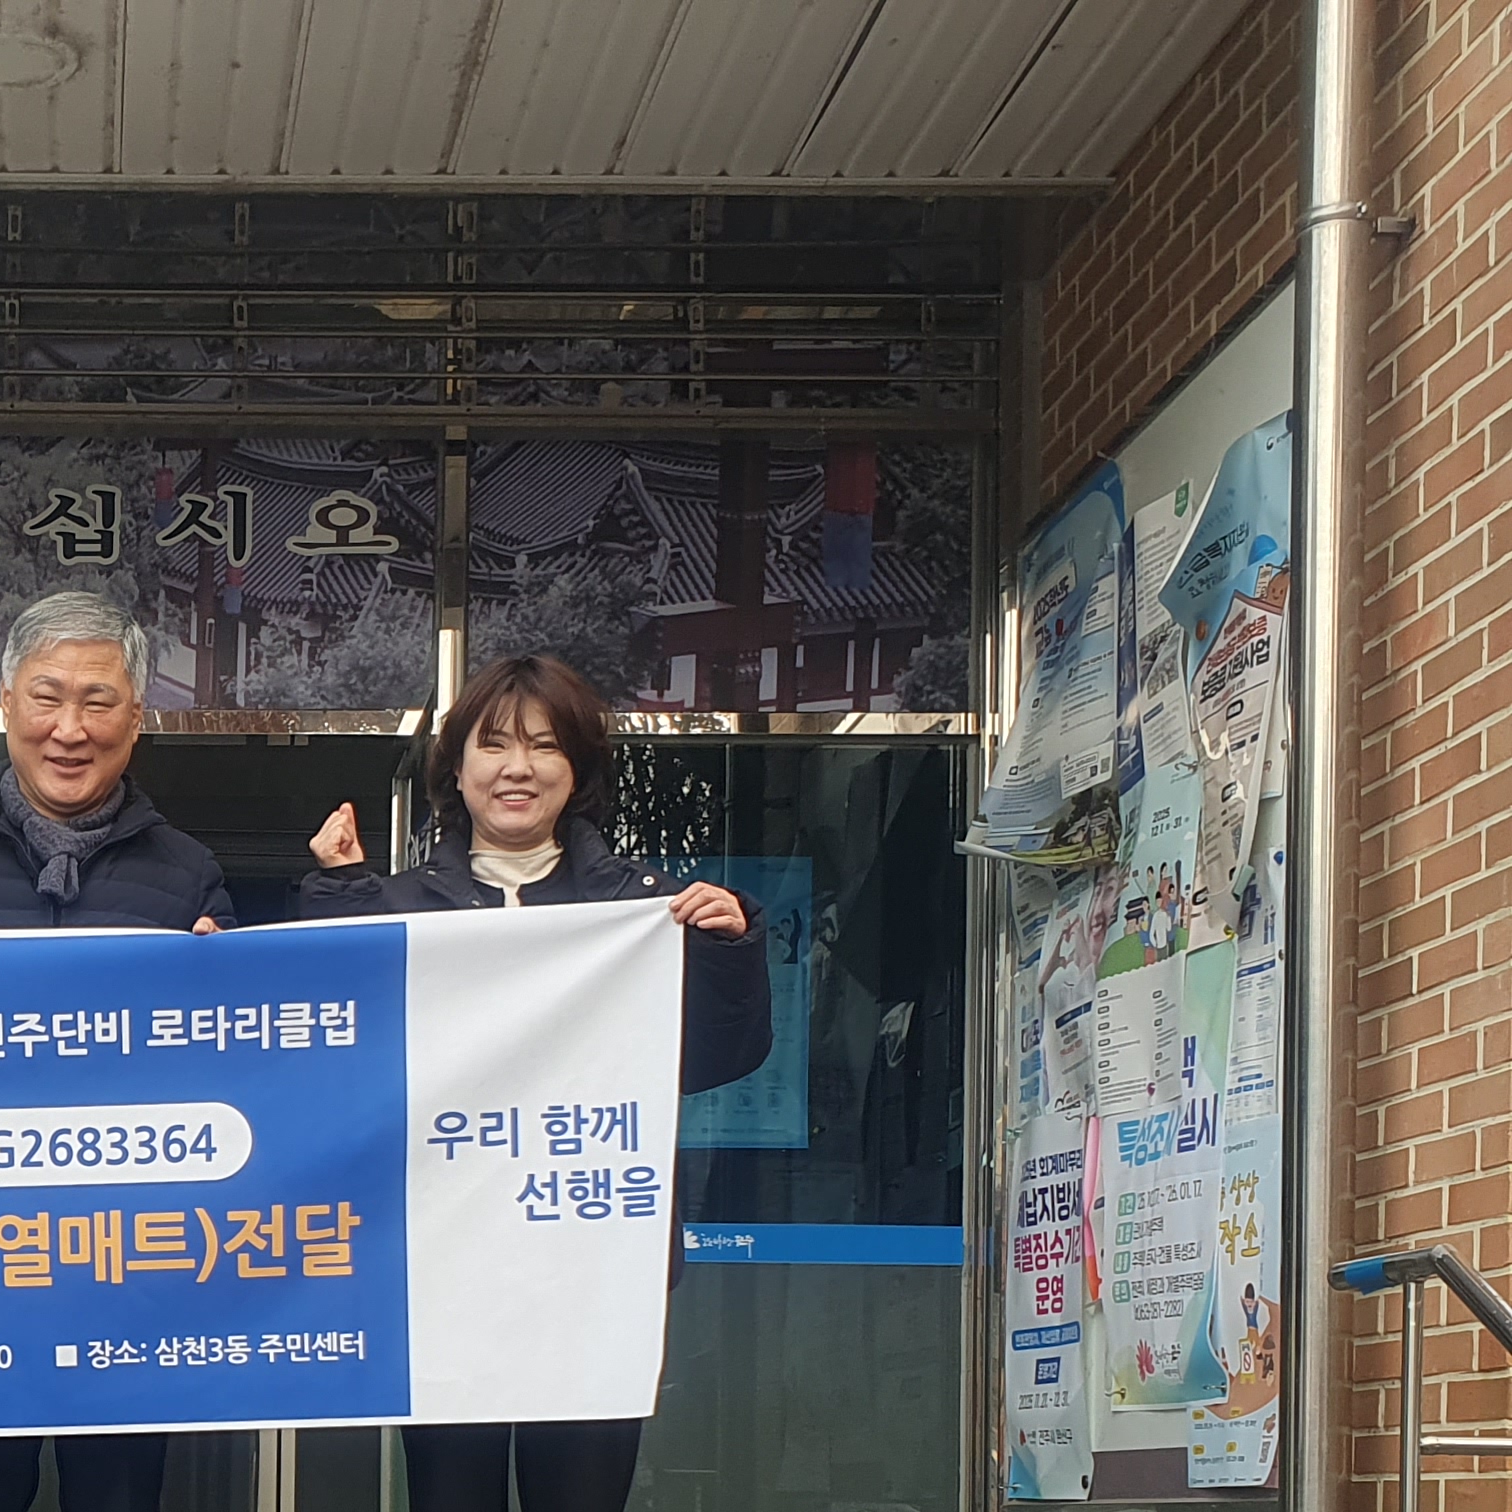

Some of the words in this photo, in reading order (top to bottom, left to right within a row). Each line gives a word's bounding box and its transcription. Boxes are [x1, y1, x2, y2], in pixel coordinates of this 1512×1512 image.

[146, 1000, 356, 1052] 로타리클럽
[426, 1107, 520, 1160] 우리
[540, 1100, 639, 1156] 함께
[1177, 1093, 1219, 1154] 실시
[515, 1165, 662, 1222] 선행을
[1036, 1274, 1064, 1316] 운영
[86, 1339, 148, 1369] 장소:
[154, 1333, 252, 1366] 삼천3동
[257, 1329, 365, 1364] 주민센터
